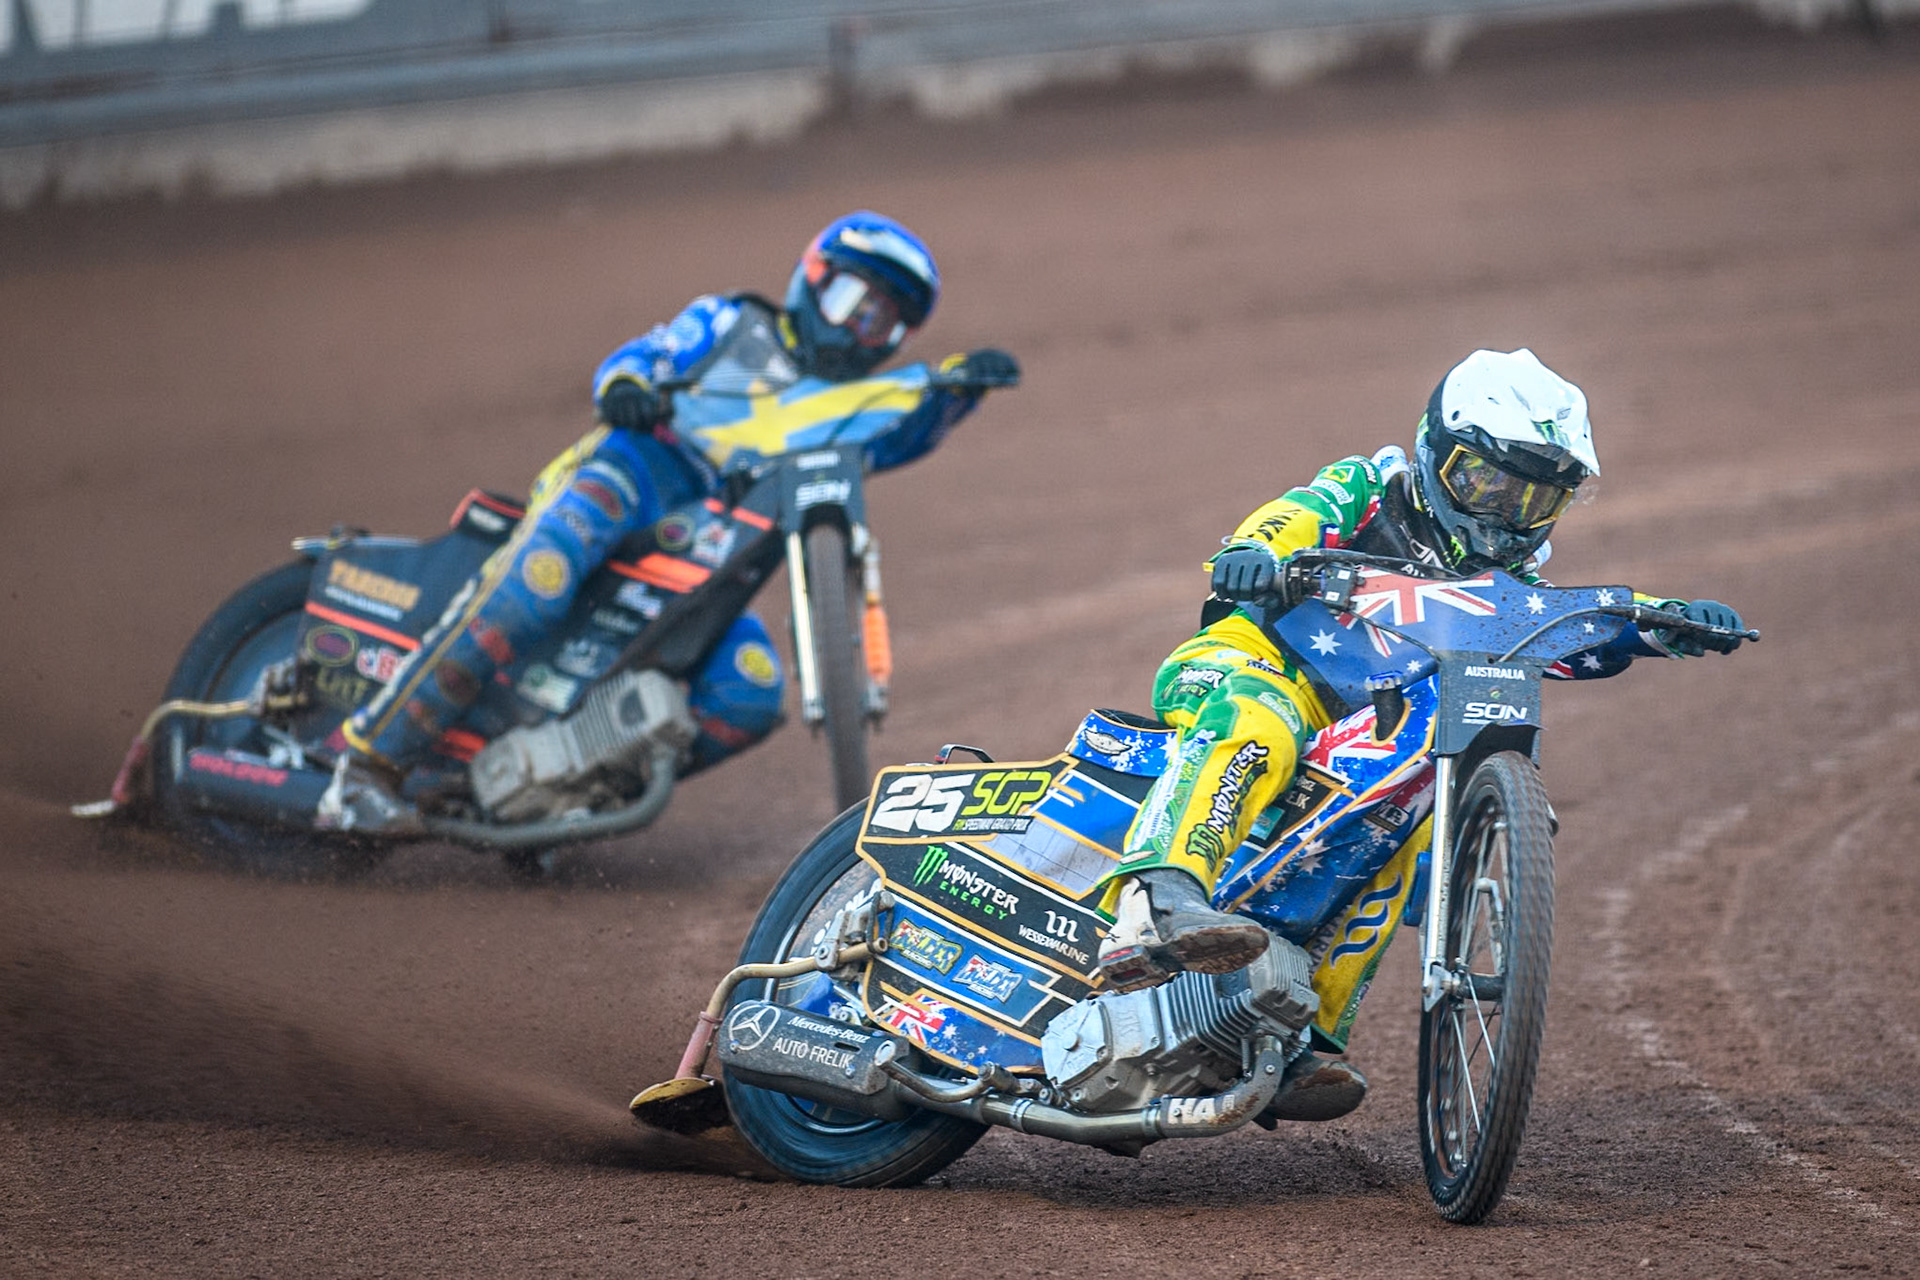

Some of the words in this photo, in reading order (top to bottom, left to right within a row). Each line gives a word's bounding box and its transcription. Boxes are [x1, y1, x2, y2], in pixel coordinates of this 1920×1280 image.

[1464, 665, 1526, 681] AUSTRALIA
[870, 773, 976, 832] 25
[960, 771, 1052, 816] SGP
[1208, 741, 1268, 833] MONSTER
[938, 860, 1020, 915] MONSTER
[939, 881, 1008, 920] ENERGY
[786, 1015, 871, 1044] Mercedes-Benz
[772, 1037, 808, 1059] AUTO
[810, 1044, 856, 1069] FRELIK
